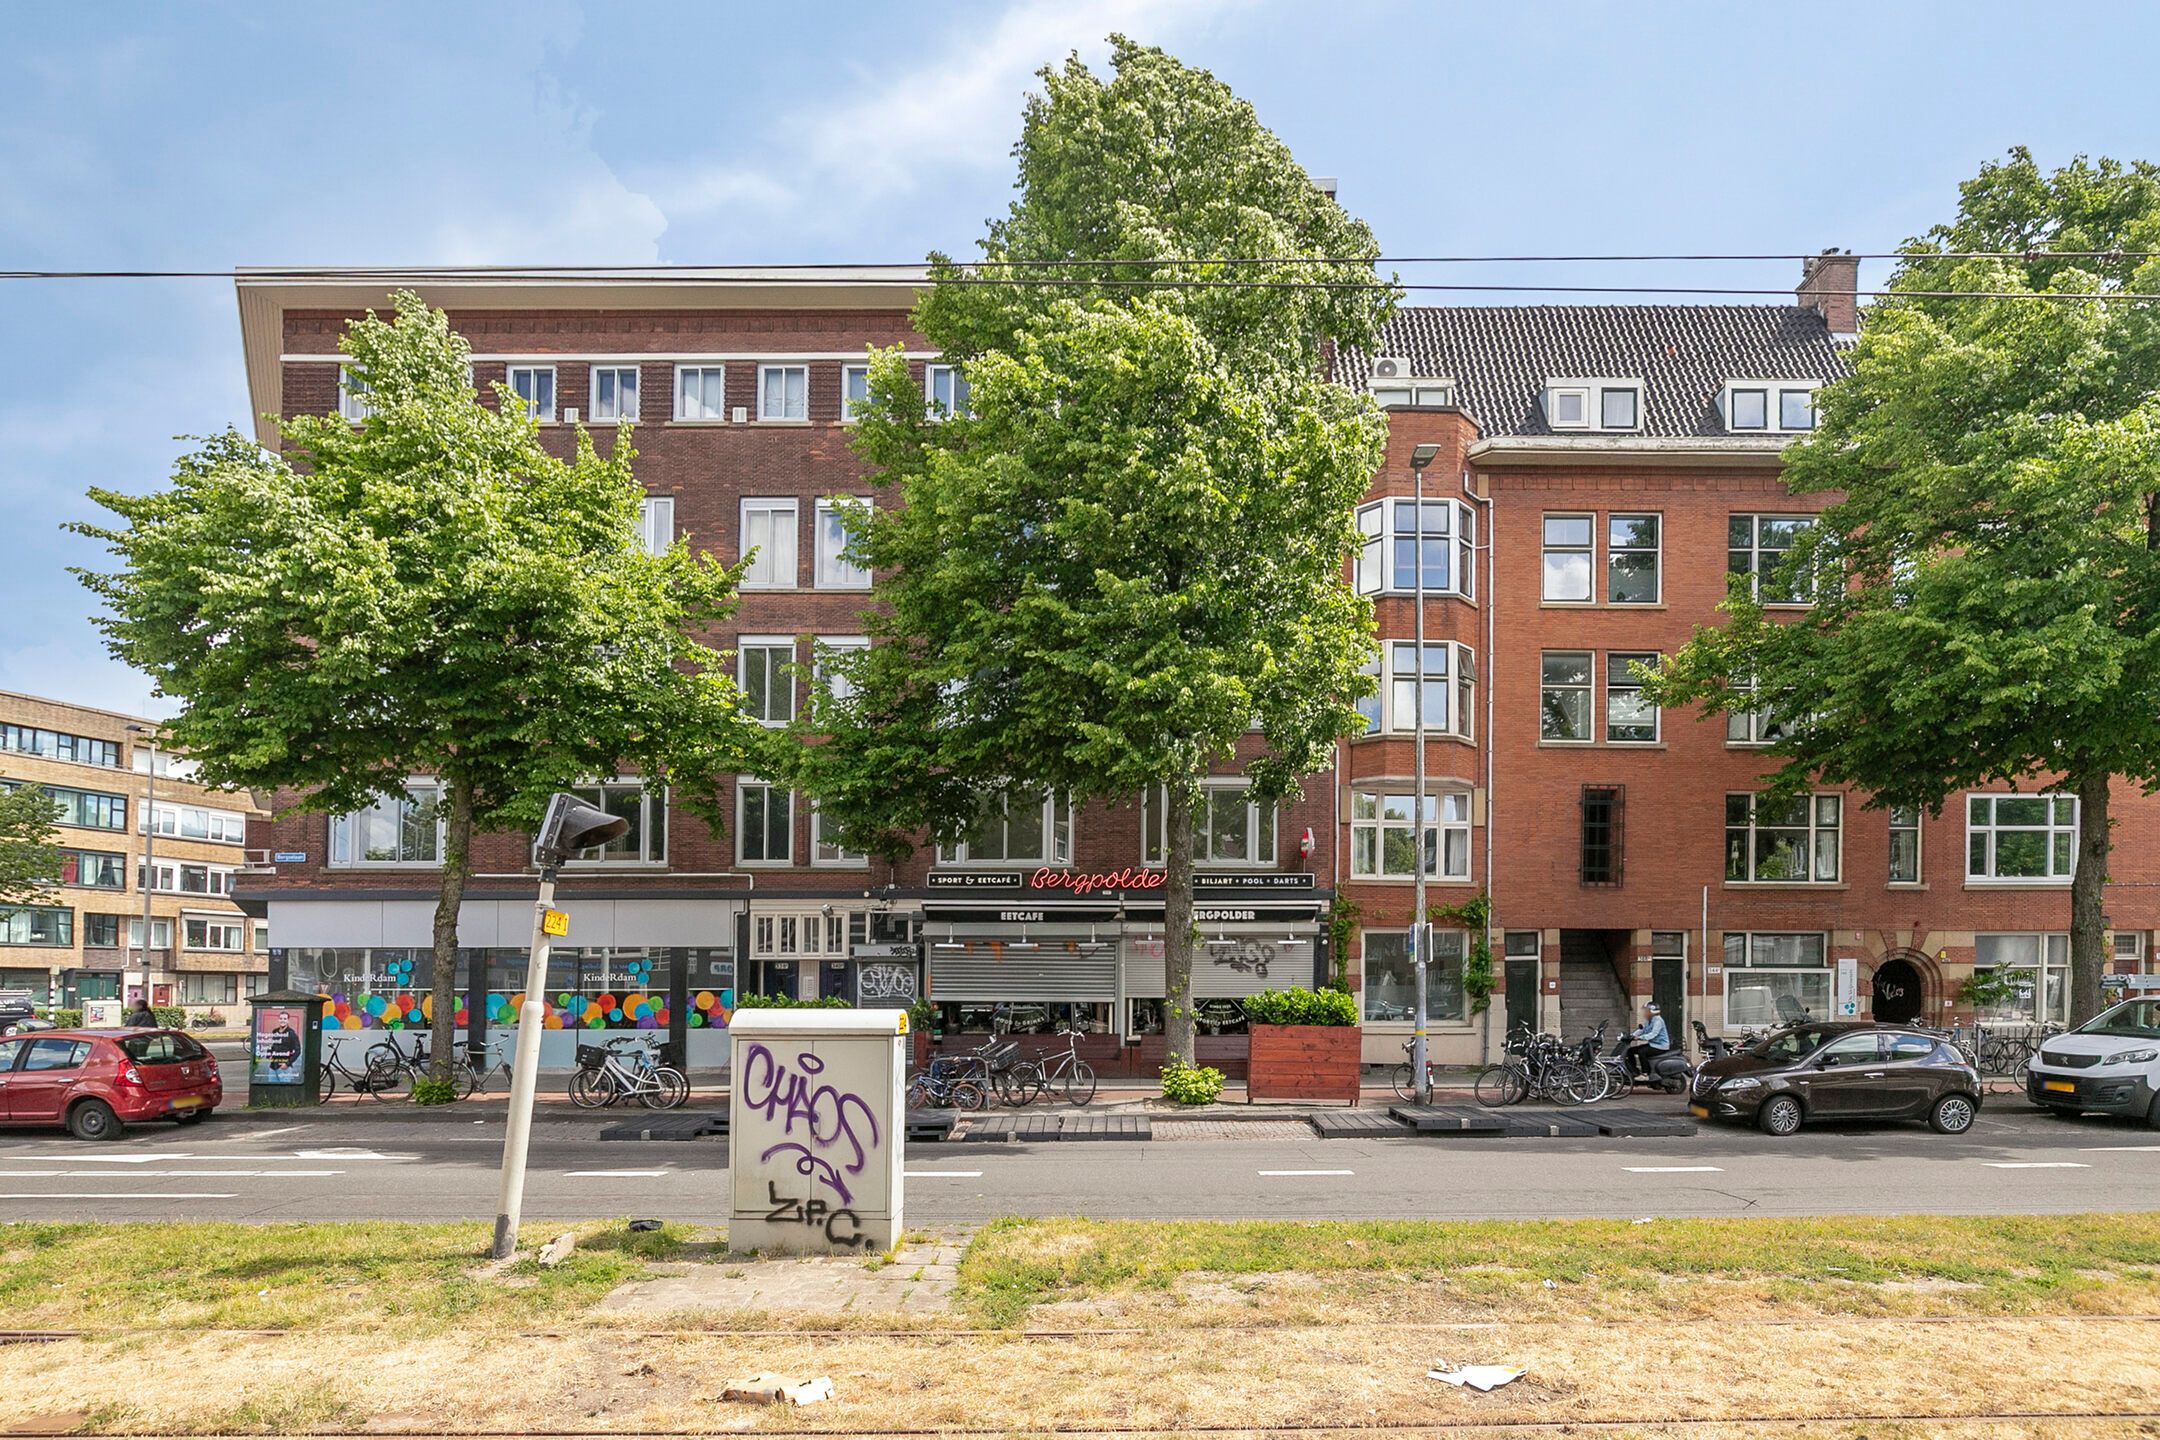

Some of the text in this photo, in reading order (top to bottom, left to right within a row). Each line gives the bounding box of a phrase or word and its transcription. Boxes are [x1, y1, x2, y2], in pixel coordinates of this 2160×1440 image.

[965, 876, 975, 885] &
[977, 875, 1011, 884] EETCAFÉ
[1000, 911, 1044, 921] EETCAFE
[1193, 910, 1256, 921] ERGPOLDER
[343, 973, 397, 983] KindeRdam
[583, 972, 637, 982] KindeRdam
